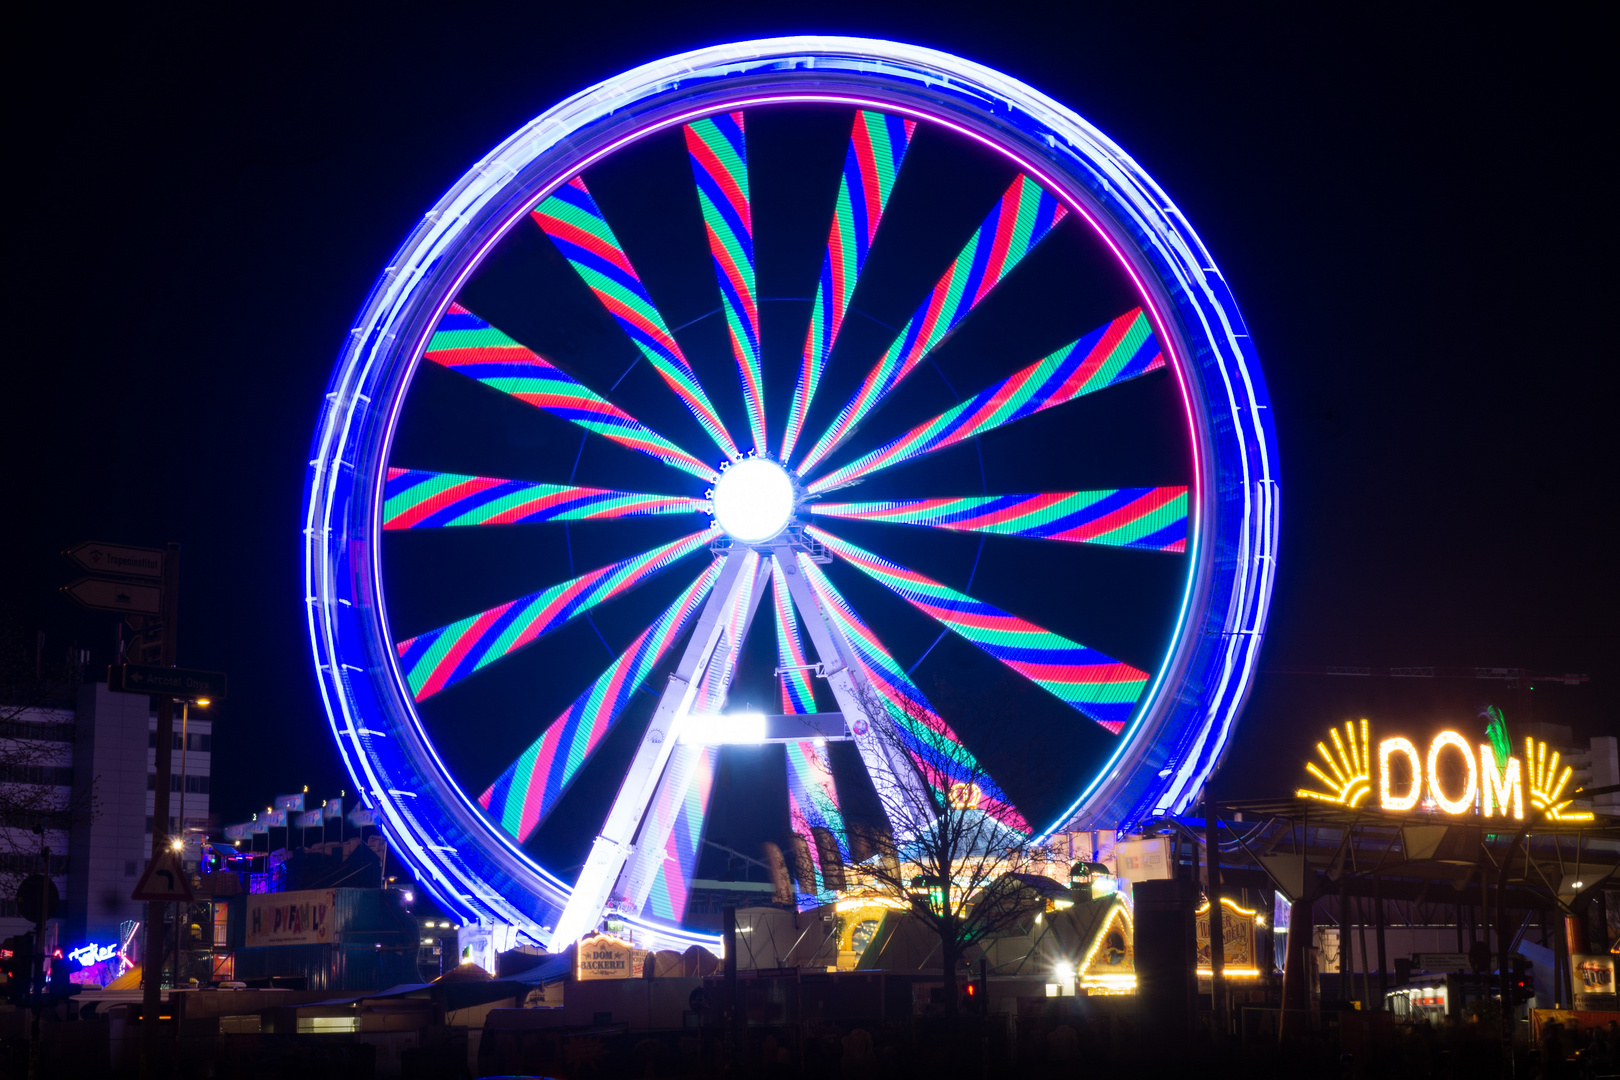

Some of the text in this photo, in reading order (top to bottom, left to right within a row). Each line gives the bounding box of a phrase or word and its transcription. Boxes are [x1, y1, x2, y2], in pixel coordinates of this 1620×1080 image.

[107, 553, 159, 569] Tropeninstitut
[147, 673, 210, 690] Arcotel Onyx
[1379, 729, 1523, 820] DOM
[593, 951, 613, 959] DOM
